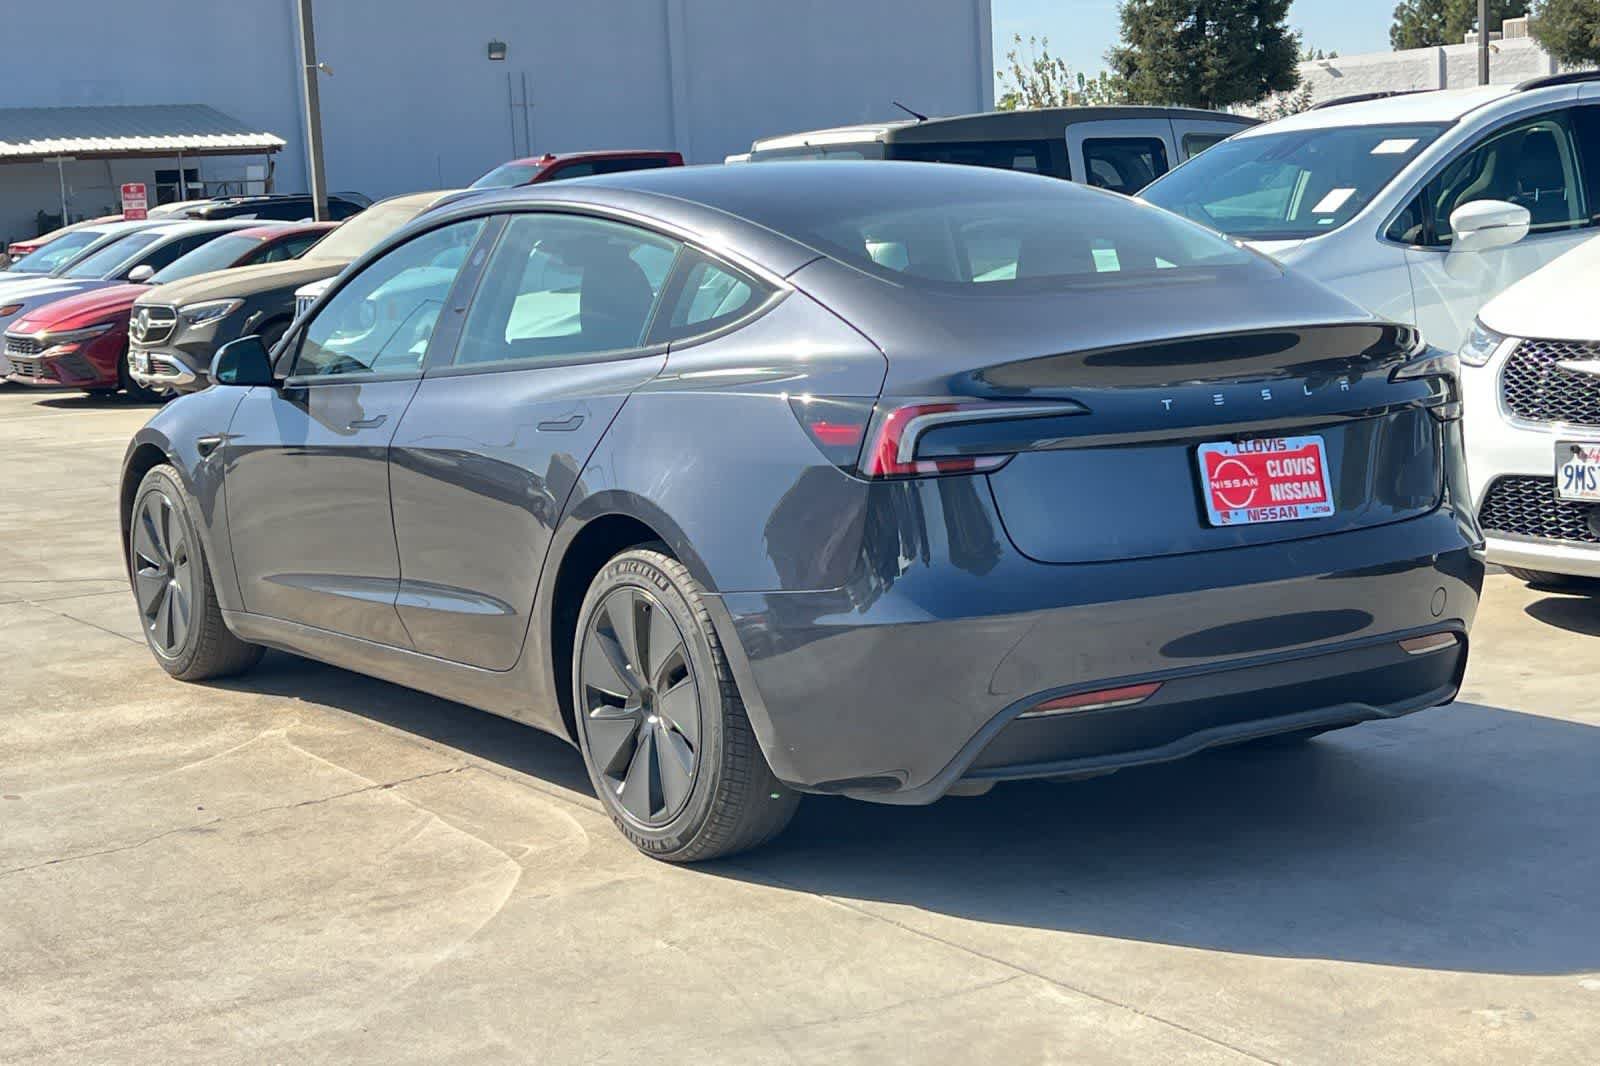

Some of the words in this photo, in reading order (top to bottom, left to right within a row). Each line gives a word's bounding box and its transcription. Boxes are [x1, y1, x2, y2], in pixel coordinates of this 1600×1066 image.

[1161, 380, 1349, 411] TESLA
[1236, 439, 1287, 454] CLOVIS
[1265, 457, 1316, 478] CLOVIS
[1564, 464, 1600, 491] 9MS
[1210, 477, 1258, 489] NISSAN
[1270, 481, 1322, 502] NISSAN
[1247, 506, 1299, 521] NISSAN
